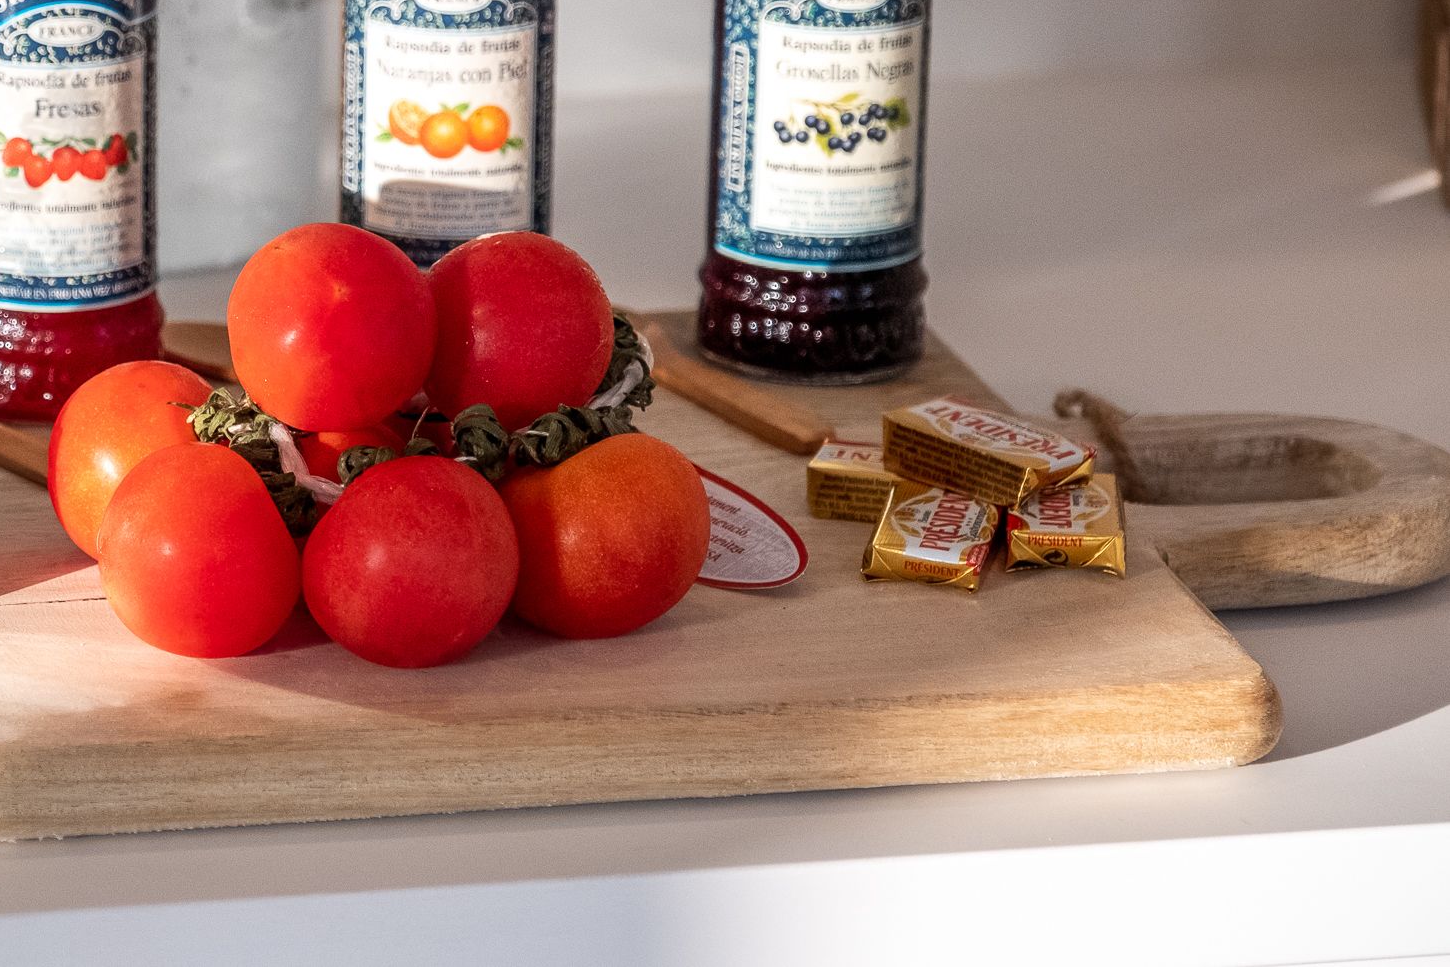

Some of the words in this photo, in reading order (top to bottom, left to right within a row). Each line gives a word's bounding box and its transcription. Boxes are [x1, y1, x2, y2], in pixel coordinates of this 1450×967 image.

[857, 38, 875, 52] de
[459, 68, 492, 84] con
[498, 57, 529, 82] Piel
[70, 74, 88, 88] de
[34, 98, 102, 119] Fresas
